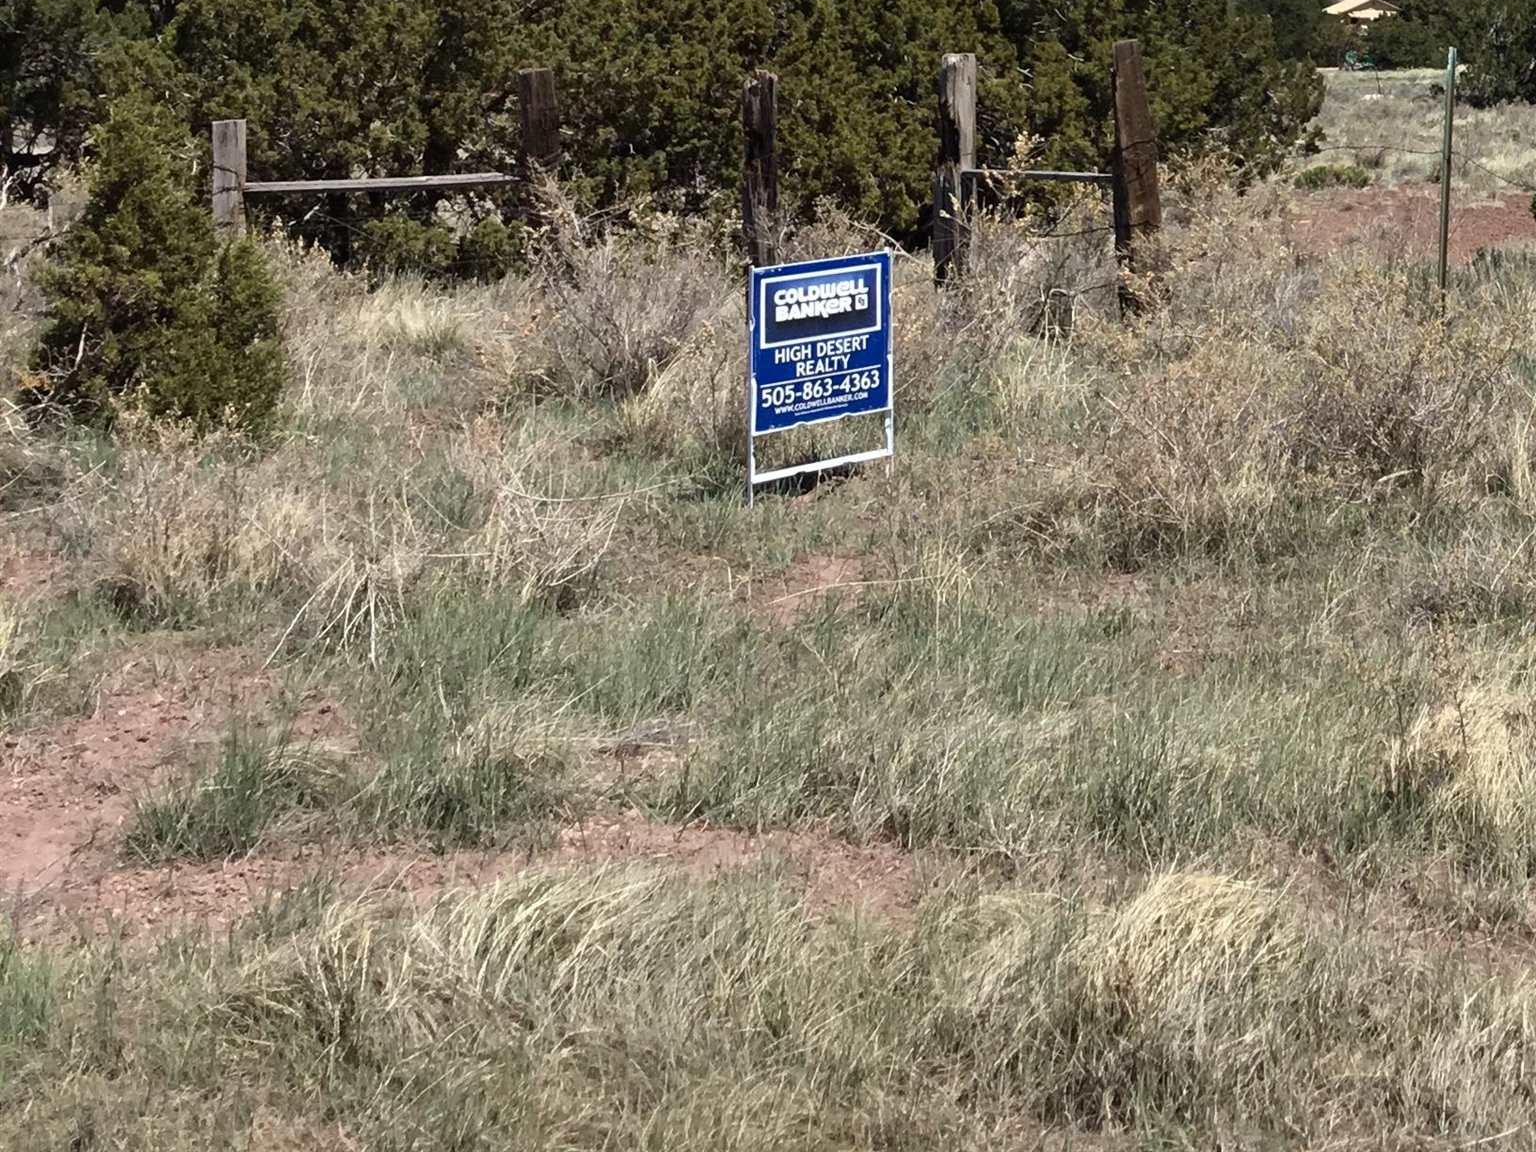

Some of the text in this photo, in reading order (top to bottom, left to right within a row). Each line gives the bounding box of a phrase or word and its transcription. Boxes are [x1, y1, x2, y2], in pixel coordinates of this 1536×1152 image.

[774, 278, 868, 305] COLDWELL
[775, 296, 852, 322] BANKER
[774, 335, 870, 364] HIGH DESERT
[796, 354, 851, 377] REALTY
[762, 369, 880, 408] 505-863-4363
